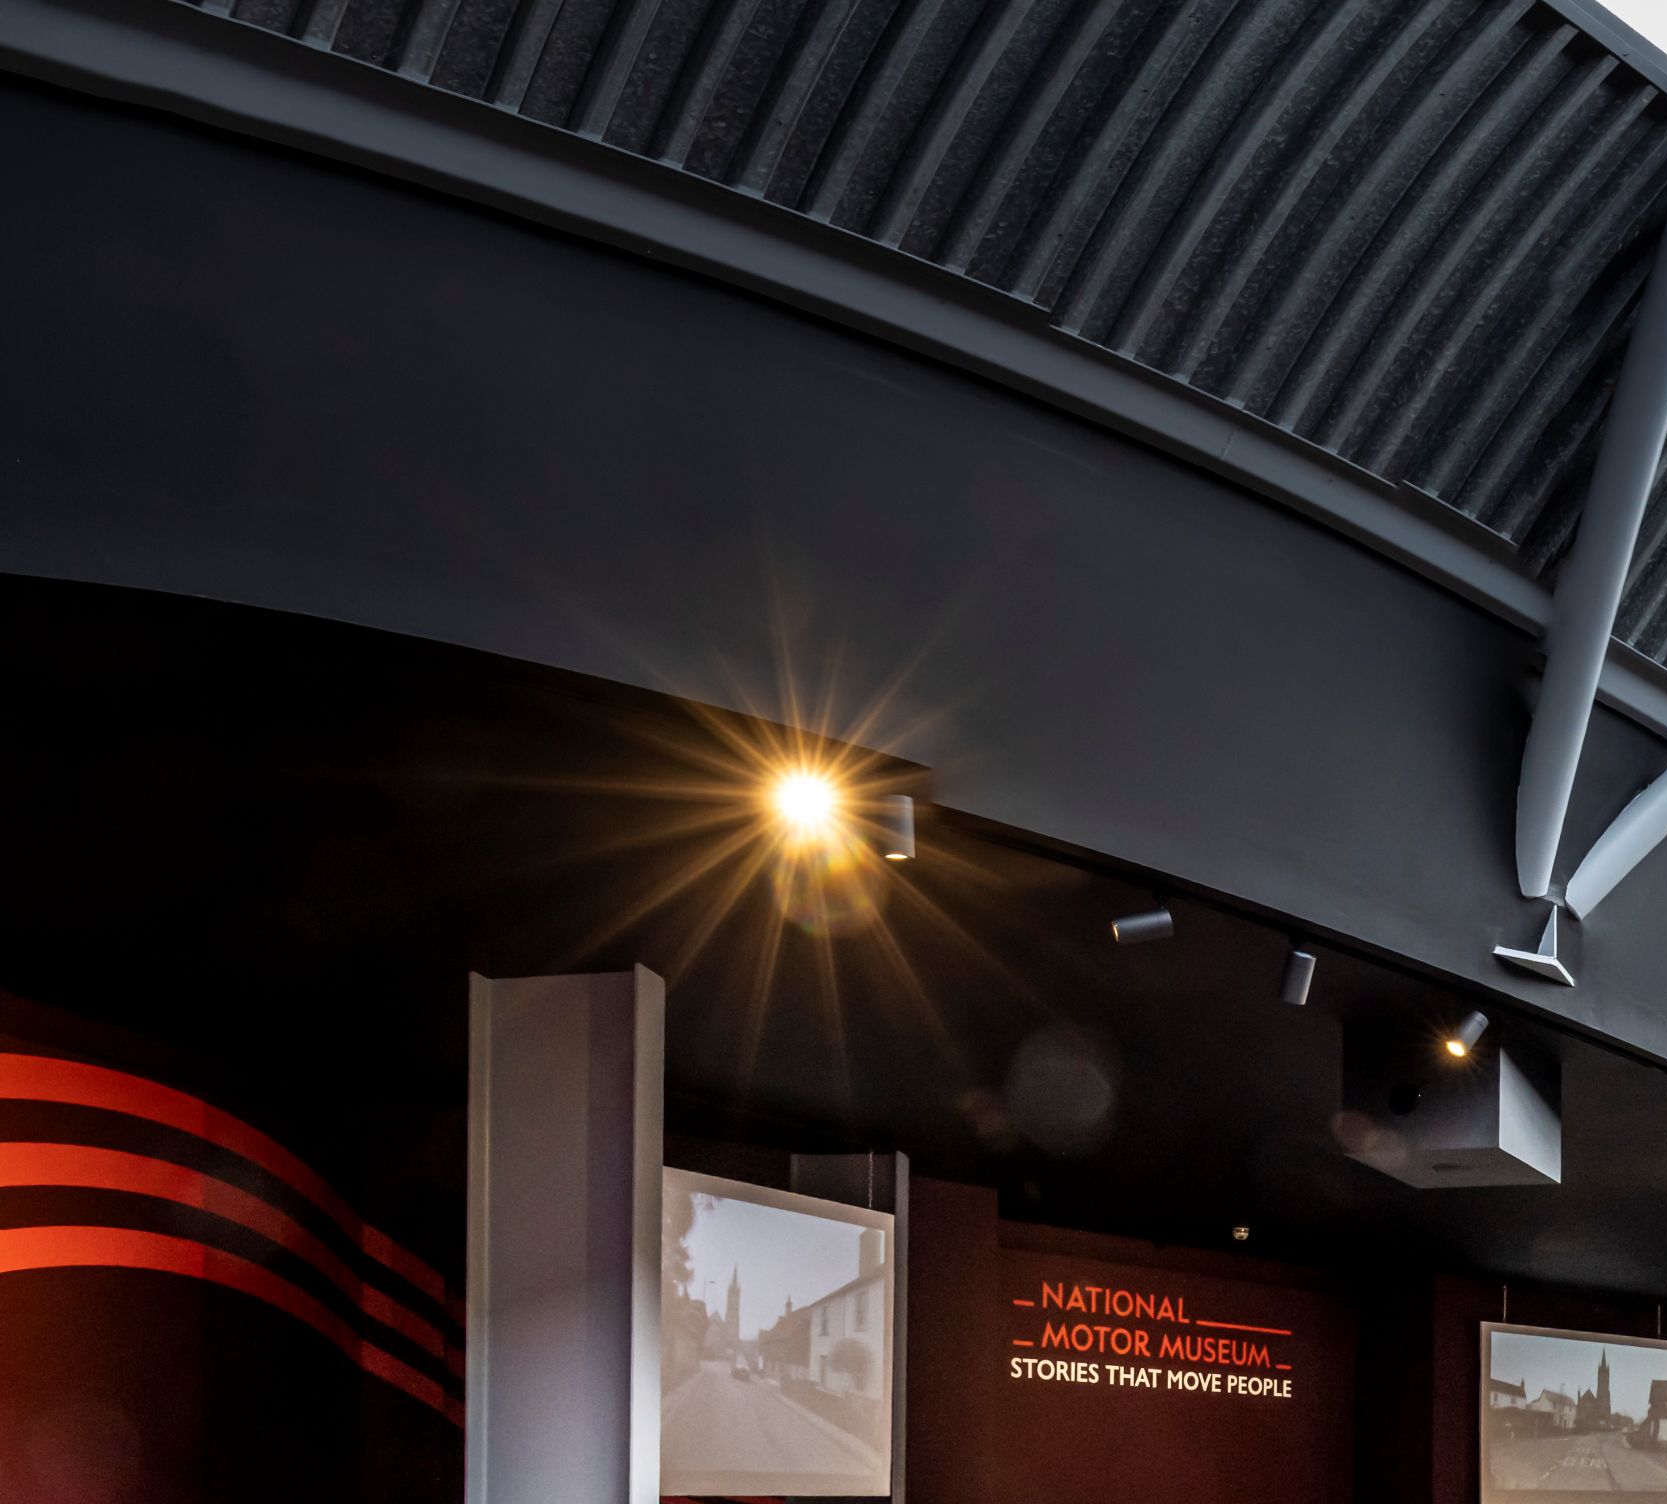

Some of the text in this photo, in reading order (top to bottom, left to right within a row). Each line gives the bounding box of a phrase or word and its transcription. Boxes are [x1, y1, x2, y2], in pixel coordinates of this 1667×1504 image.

[1042, 1281, 1190, 1324] NATIONAL
[1041, 1322, 1271, 1368] MOTOR MUSEUM
[1010, 1357, 1292, 1398] STORIES THAT MOVE PEOPLE
